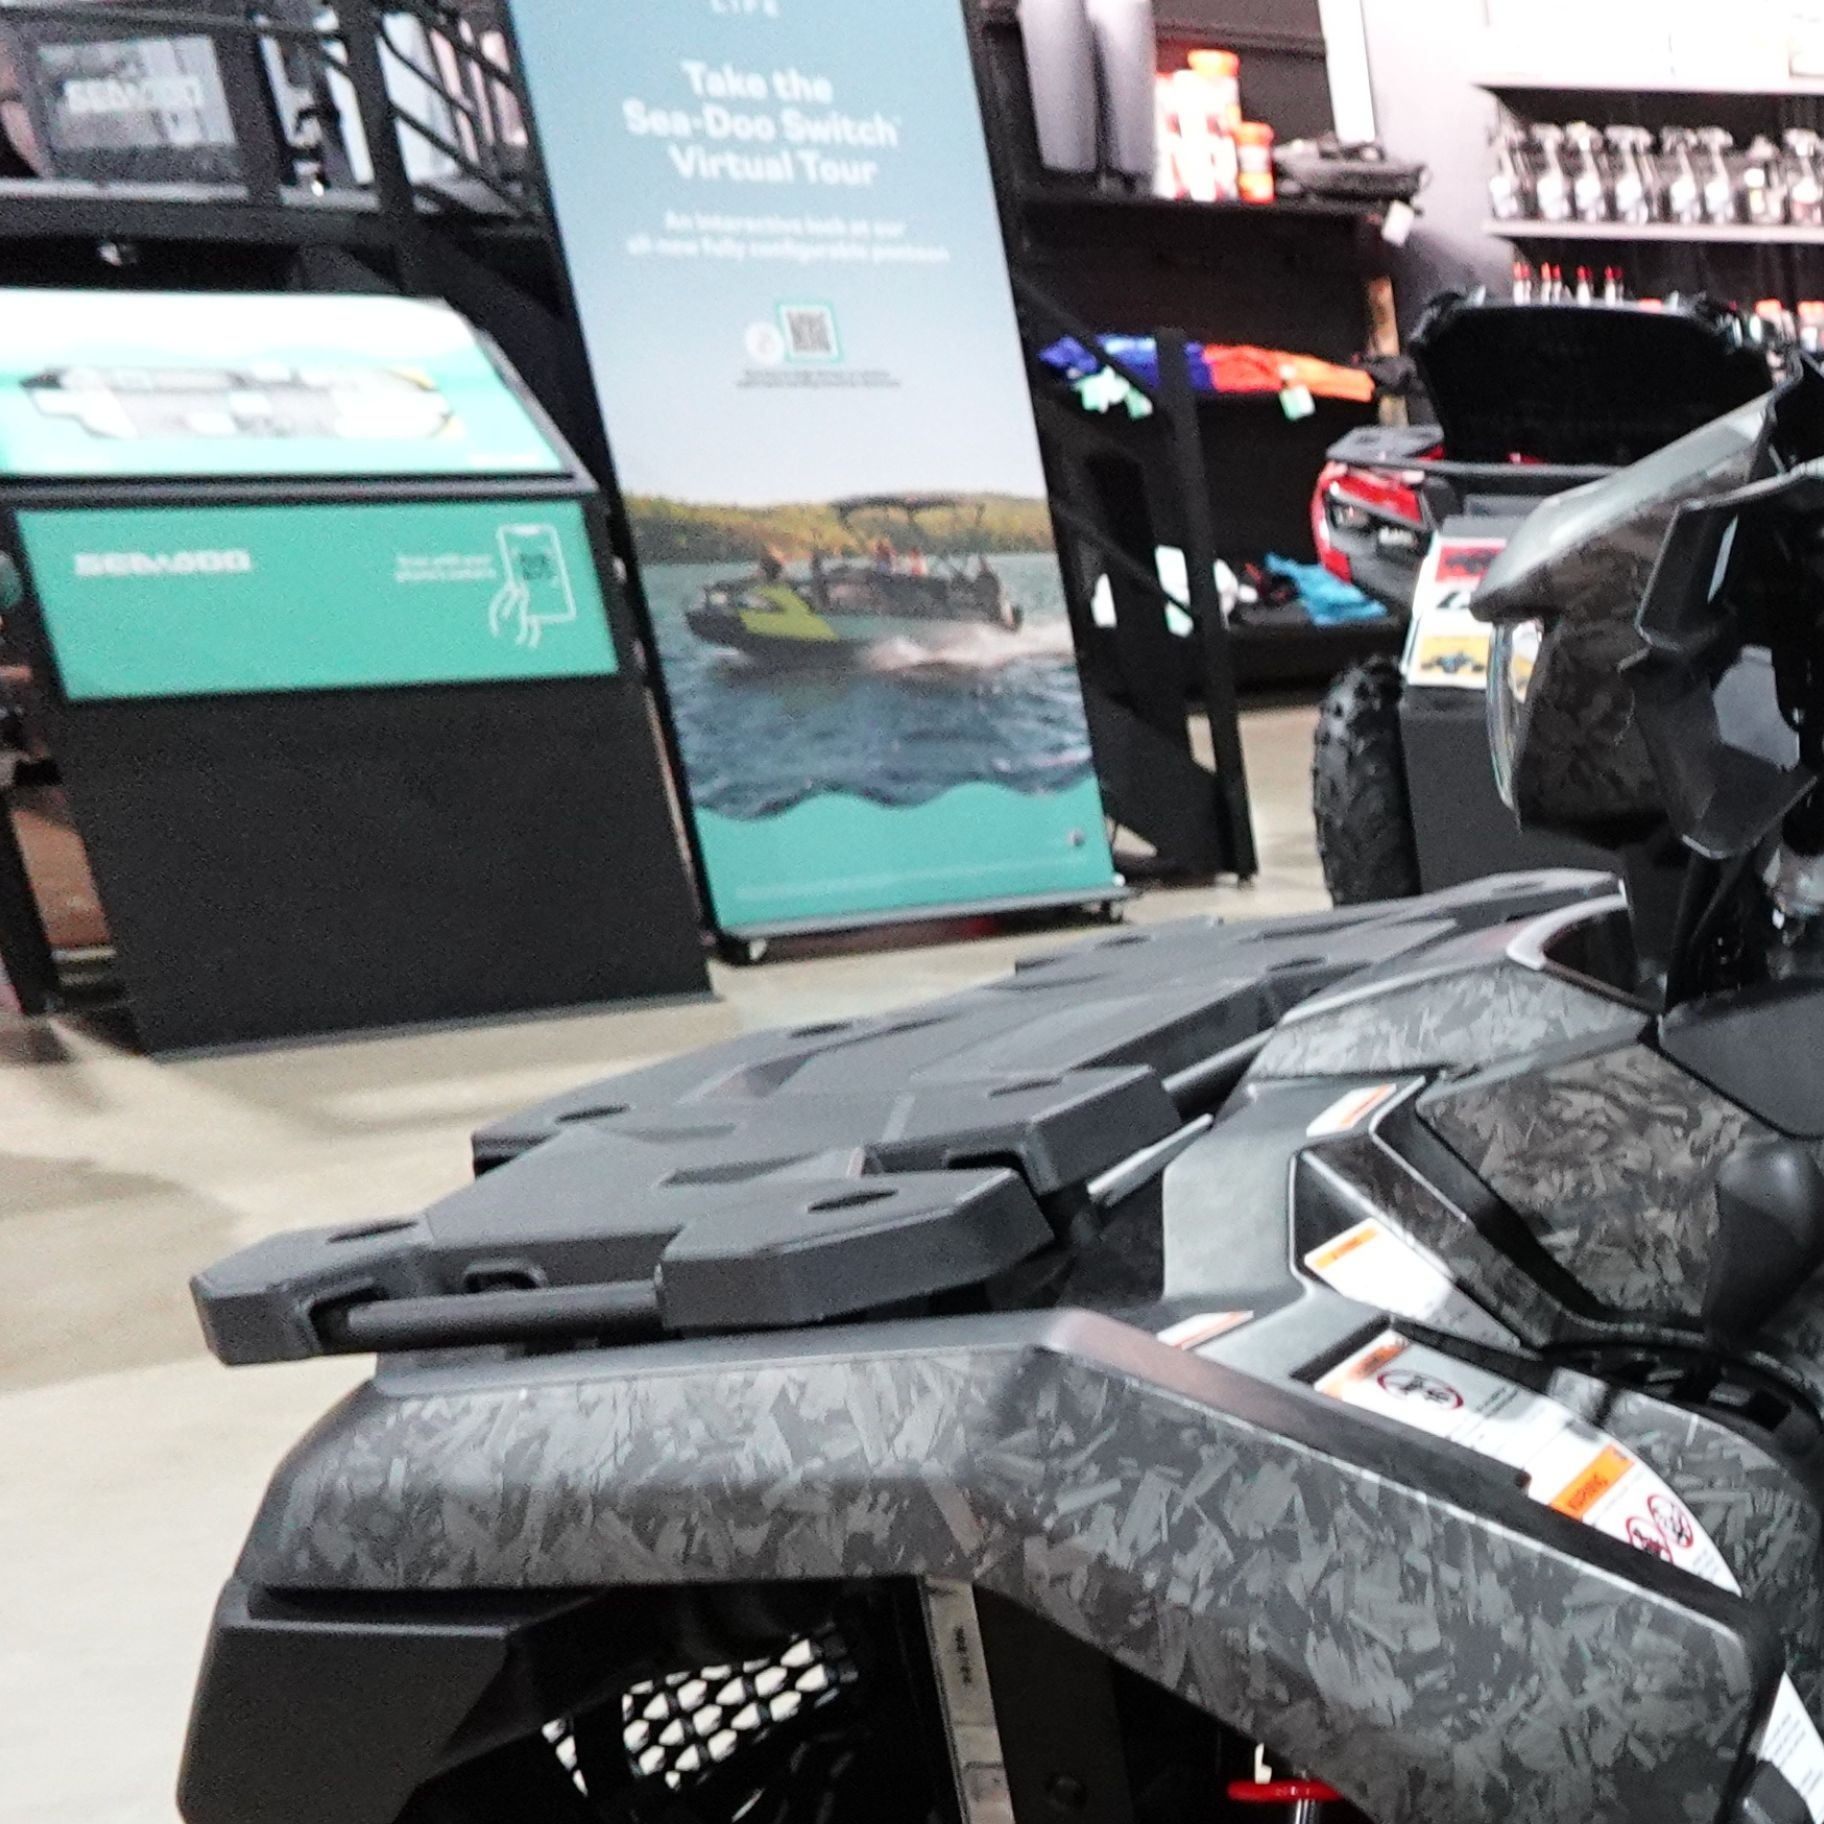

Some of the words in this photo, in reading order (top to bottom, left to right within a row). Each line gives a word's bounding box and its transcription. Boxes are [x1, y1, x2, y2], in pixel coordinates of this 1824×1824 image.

[681, 60, 768, 99] Take
[772, 67, 835, 105] the
[622, 98, 776, 143] Sea-Doo
[780, 106, 900, 148] Switch
[668, 143, 794, 184] Virtual
[798, 150, 878, 187] Tour
